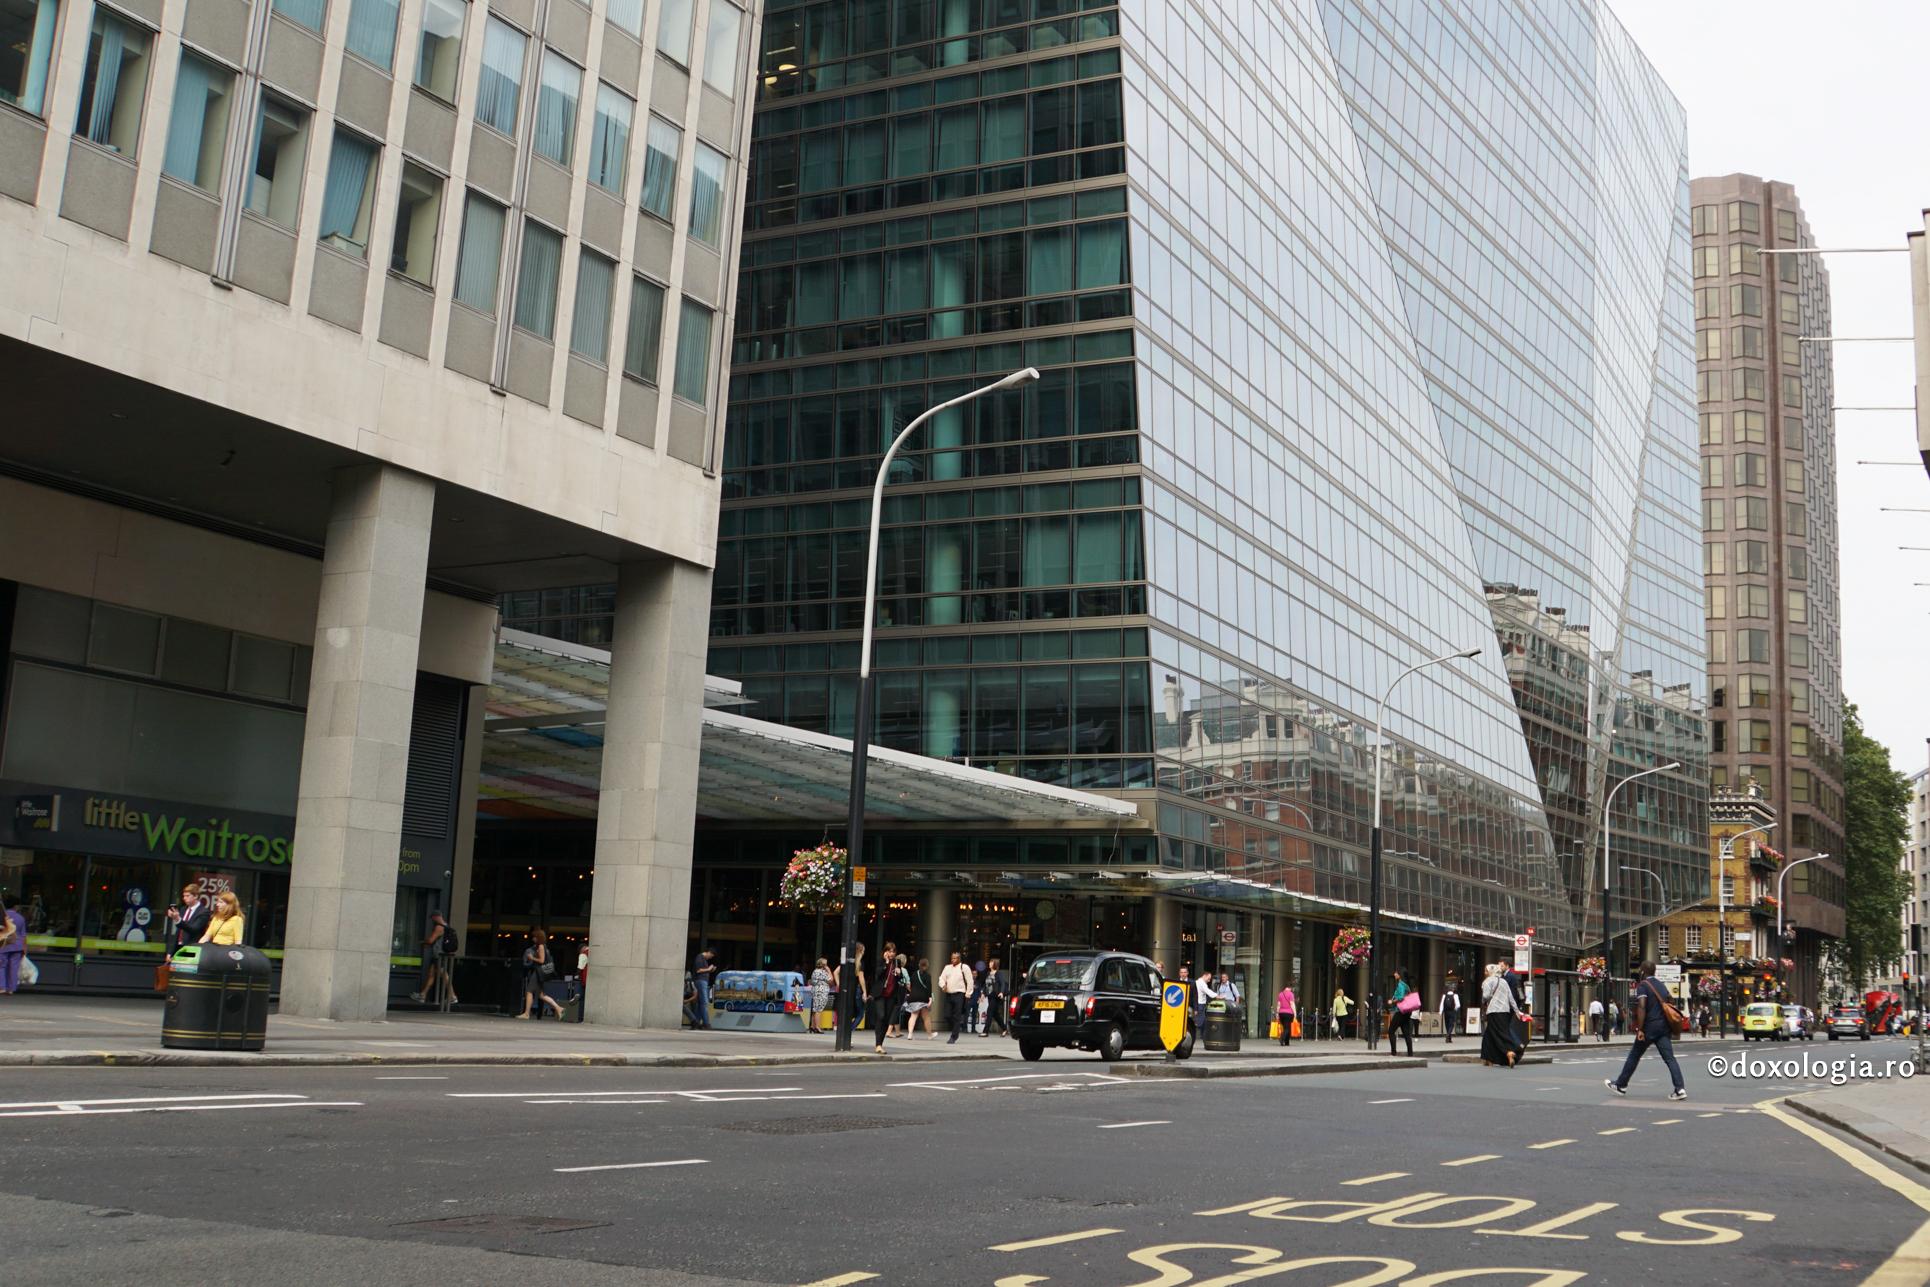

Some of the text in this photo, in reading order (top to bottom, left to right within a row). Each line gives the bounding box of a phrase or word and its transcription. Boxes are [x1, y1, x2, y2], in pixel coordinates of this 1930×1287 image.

[84, 796, 140, 831] little
[198, 876, 230, 893] 25%
[1250, 1192, 1775, 1245] STOP
